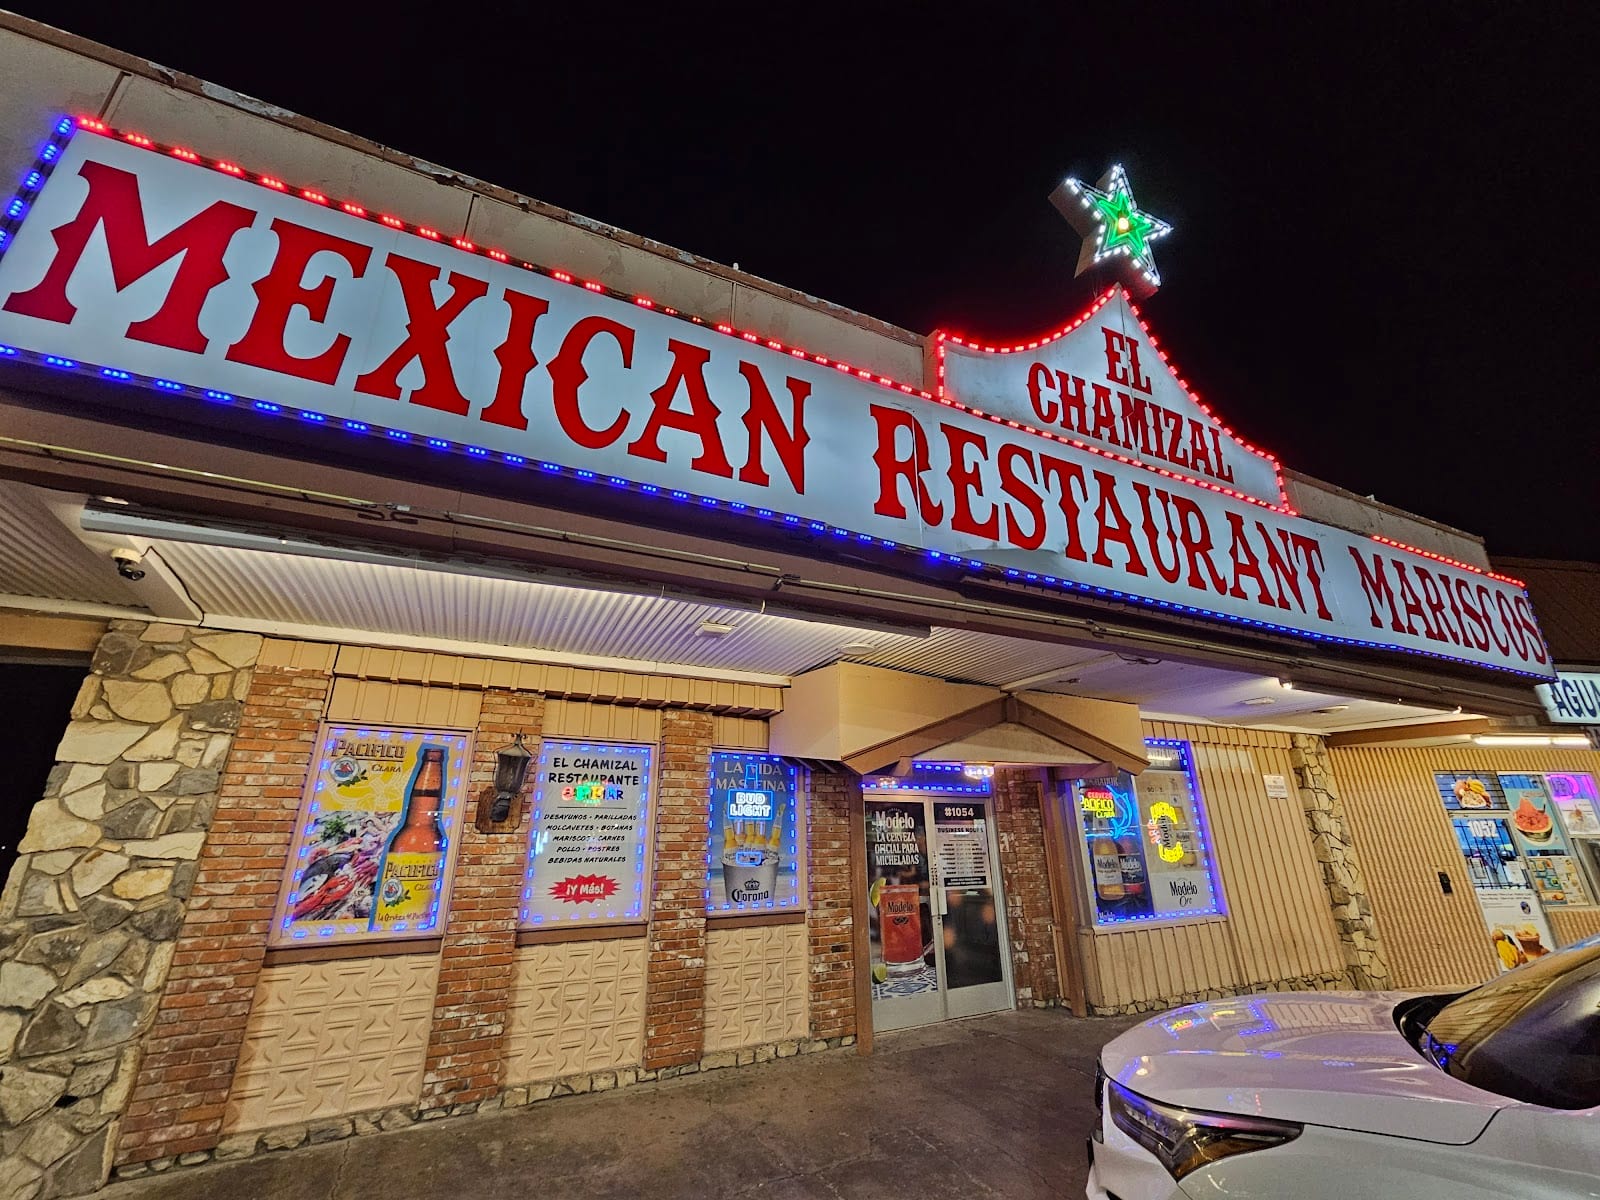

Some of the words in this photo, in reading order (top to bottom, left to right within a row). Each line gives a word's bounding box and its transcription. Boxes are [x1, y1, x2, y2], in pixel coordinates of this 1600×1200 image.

[1102, 327, 1152, 396] EL
[2, 160, 811, 496] MEXICAN
[870, 404, 1333, 621] RESTAURANT
[1348, 545, 1547, 665] MARISCOS
[1028, 361, 1234, 485] CHAMIZAL
[331, 738, 407, 758] PACIFICO
[371, 763, 401, 773] CLARA
[553, 757, 568, 768] EL
[573, 758, 638, 771] CHAMIZAL
[724, 762, 744, 774] LA
[548, 772, 639, 786] RESTAURANTE
[736, 791, 766, 805] BUD
[1079, 794, 1114, 810] PACIFICO
[730, 804, 771, 817] LIGHT
[944, 807, 975, 817] #1054
[875, 810, 915, 830] Modelo
[1467, 820, 1499, 838] 1052
[876, 830, 886, 843] LA
[902, 843, 919, 853] PARA
[876, 854, 920, 866] MICHELADAS
[1169, 880, 1198, 896] Modelo
[731, 889, 769, 903] Corona
[887, 901, 914, 913] Modelo
